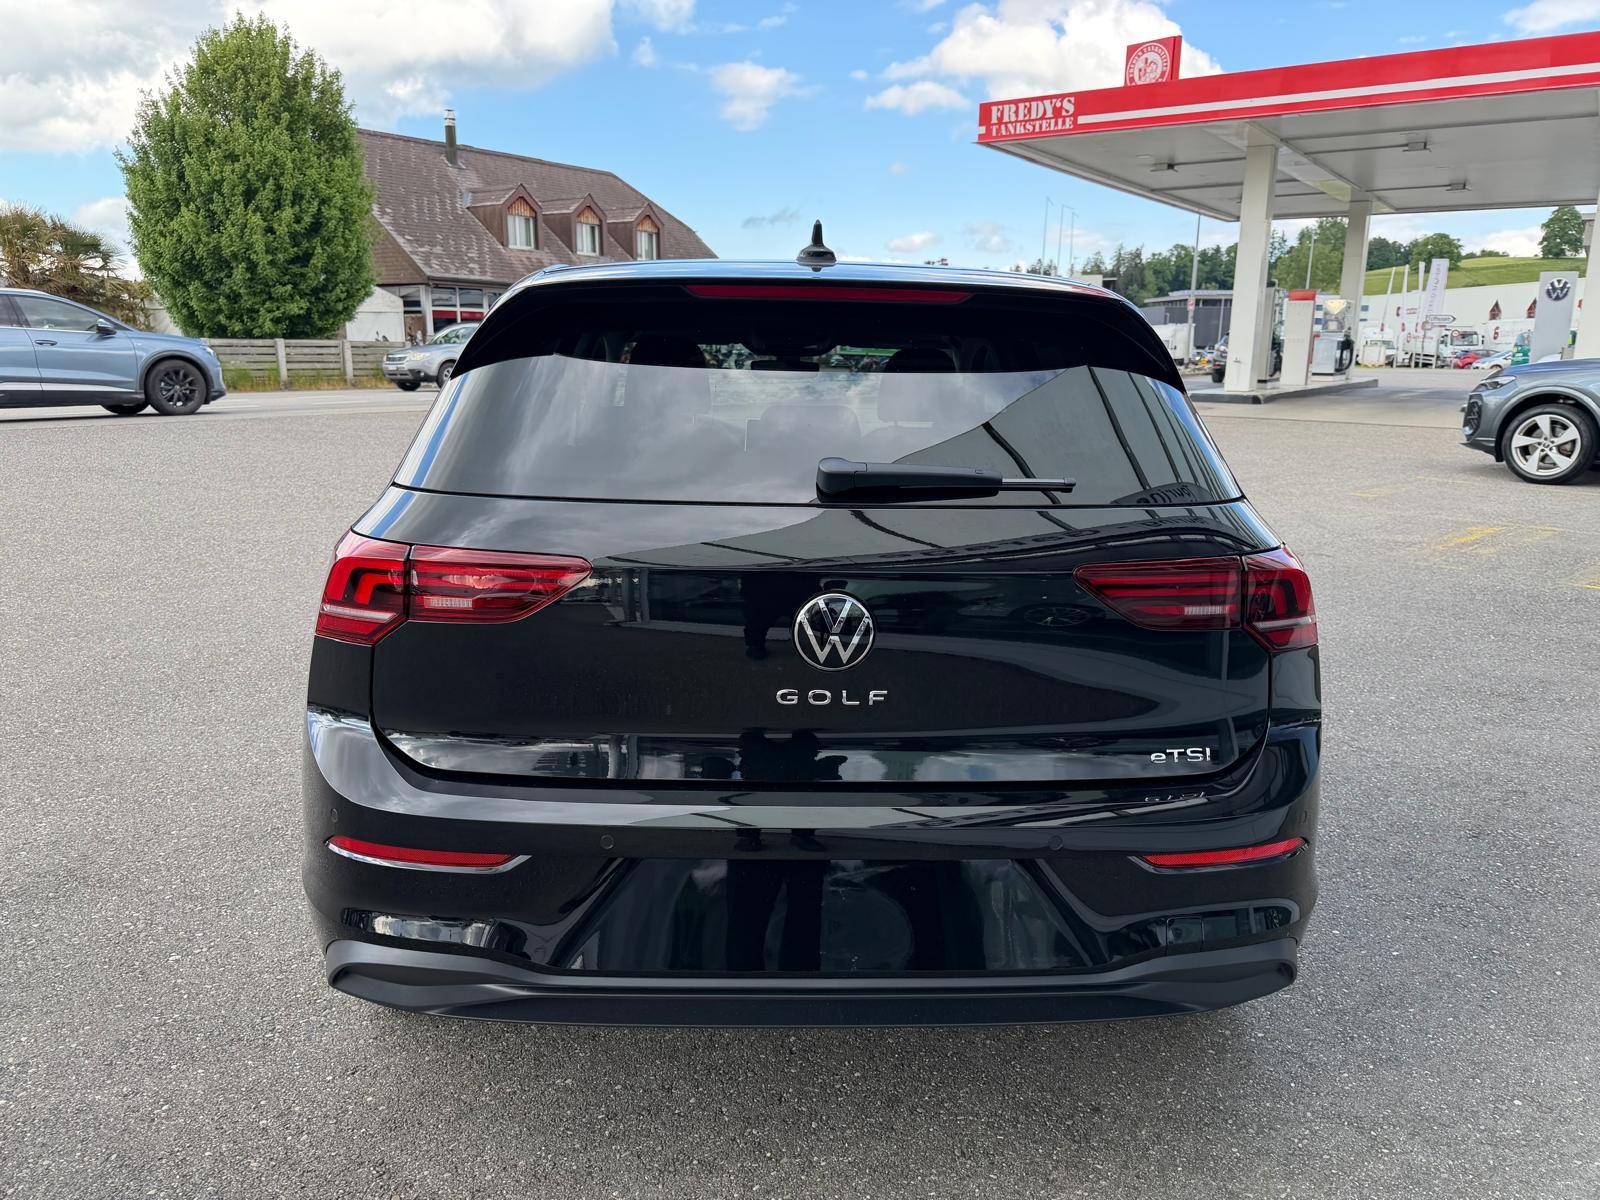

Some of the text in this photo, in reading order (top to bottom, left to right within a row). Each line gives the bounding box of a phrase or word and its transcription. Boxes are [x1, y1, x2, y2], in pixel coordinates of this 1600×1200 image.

[990, 97, 1075, 124] FREDY'S
[990, 117, 1074, 136] TANKSTELLE
[796, 594, 873, 669] VW
[775, 688, 888, 706] GOLF
[1150, 747, 1211, 764] eTSI
